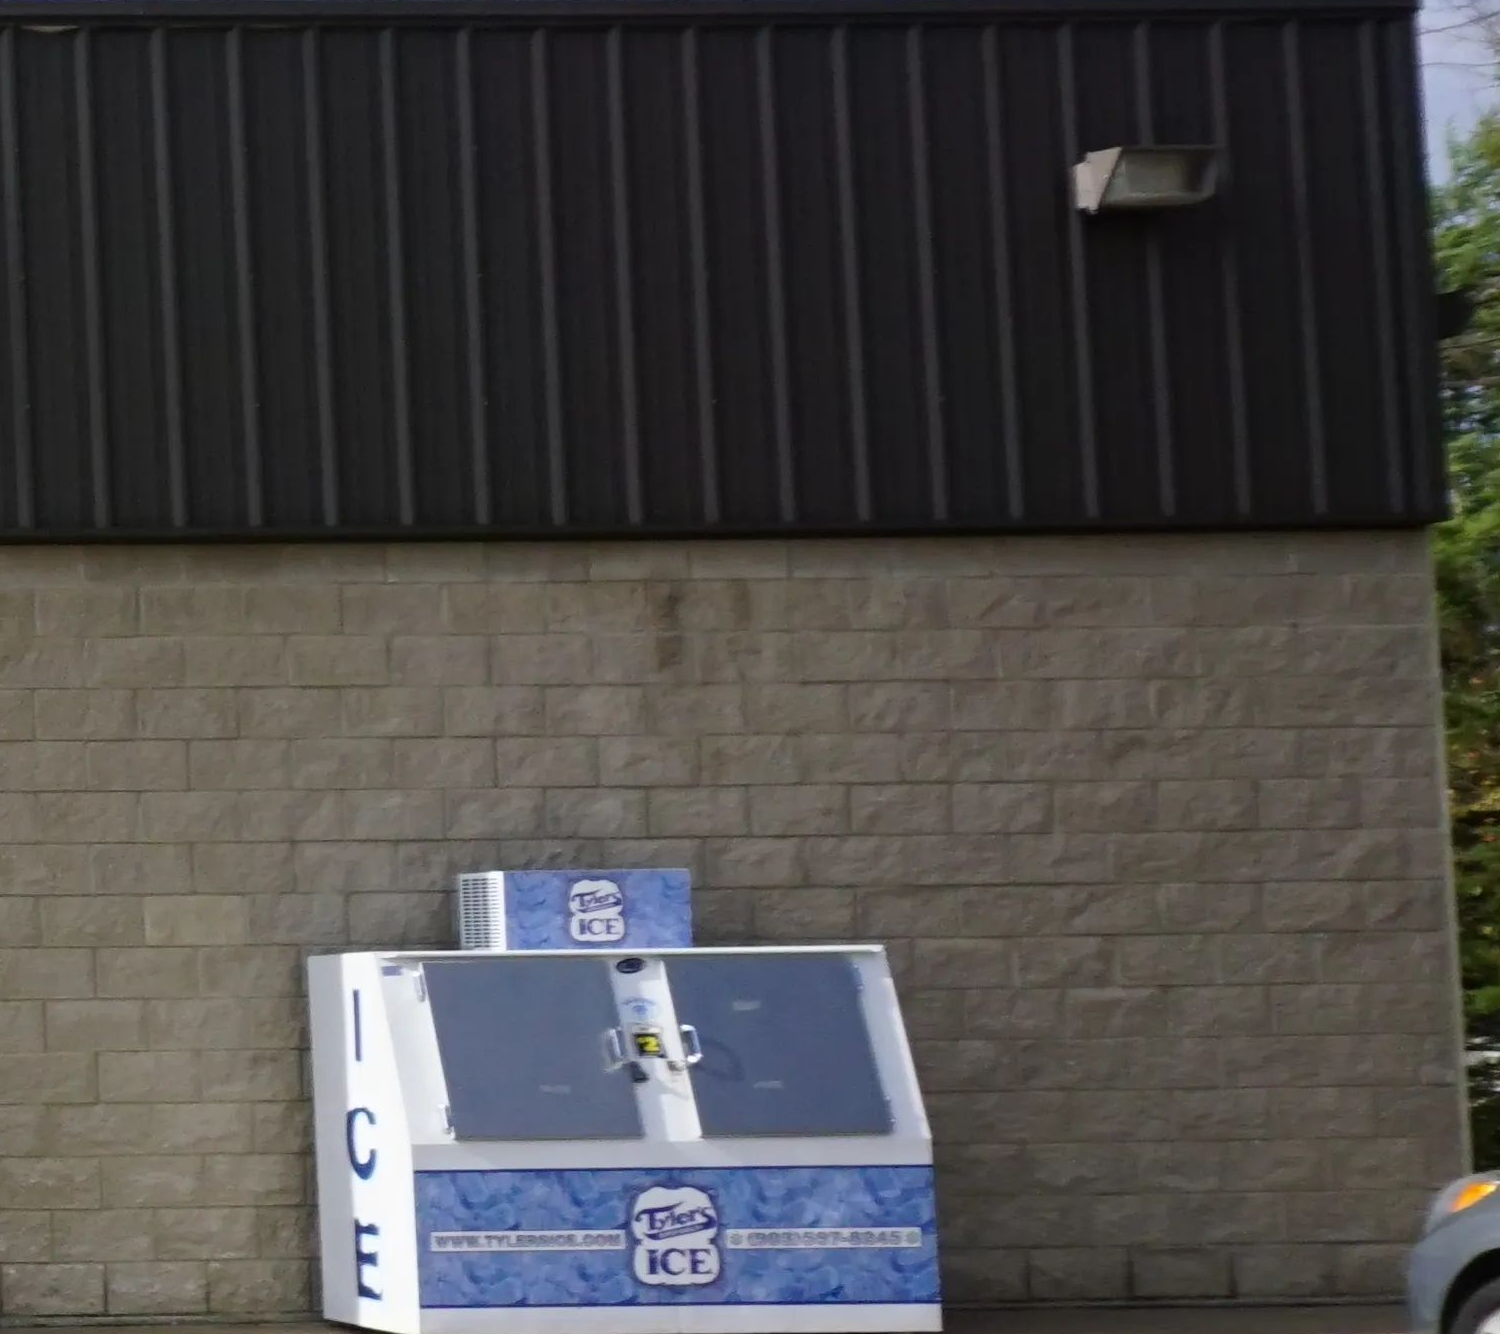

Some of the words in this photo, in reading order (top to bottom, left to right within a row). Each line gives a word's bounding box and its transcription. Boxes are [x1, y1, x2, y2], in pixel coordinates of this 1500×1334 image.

[578, 918, 621, 935] ICE
[347, 989, 383, 1301] ICE
[646, 1248, 714, 1276] ICE
